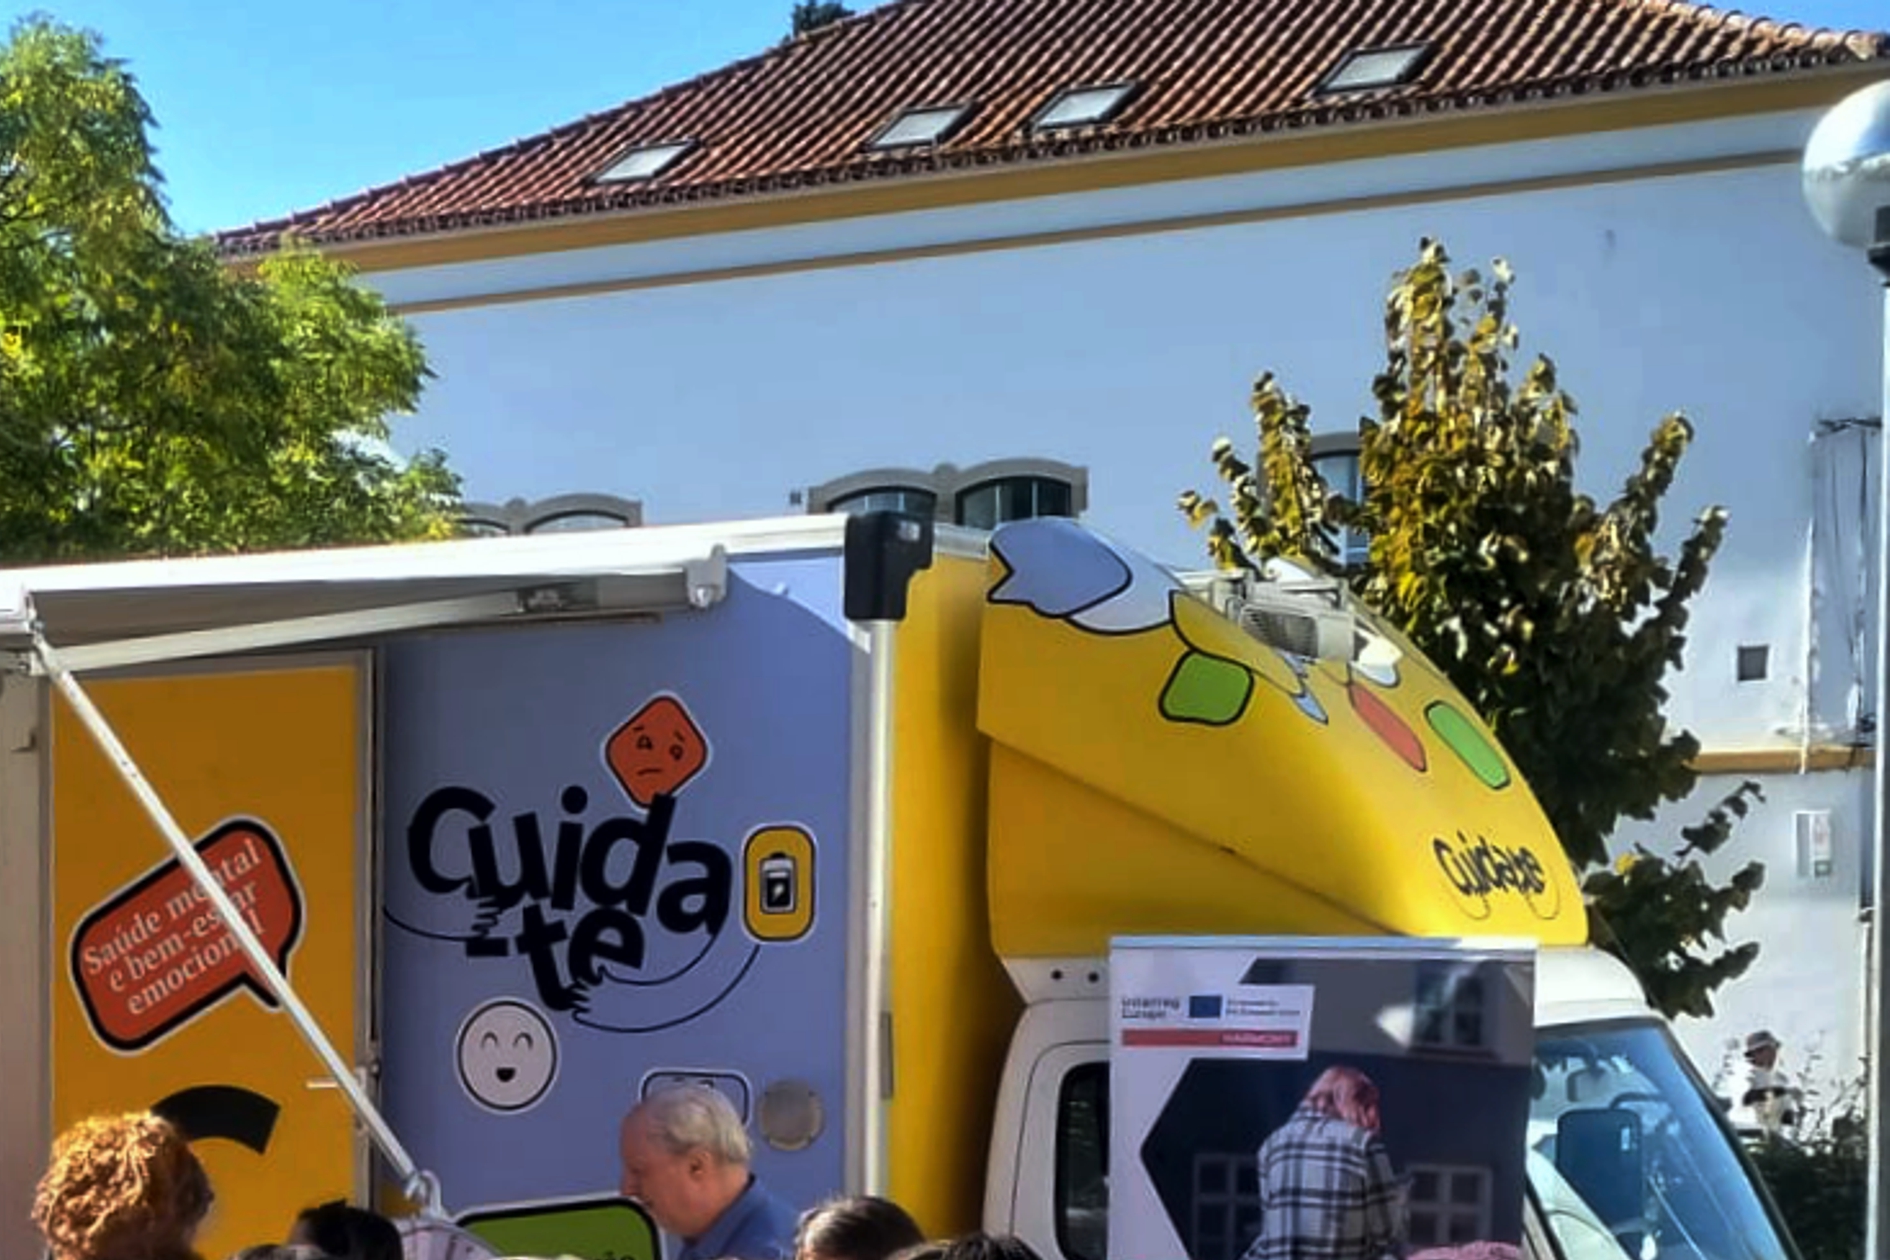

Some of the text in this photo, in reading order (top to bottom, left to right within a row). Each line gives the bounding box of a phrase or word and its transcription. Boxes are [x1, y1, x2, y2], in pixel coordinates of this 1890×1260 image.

[407, 785, 733, 933] Cuida
[83, 911, 161, 976] Saúde
[110, 968, 124, 992] e
[127, 909, 265, 1015] emocionl
